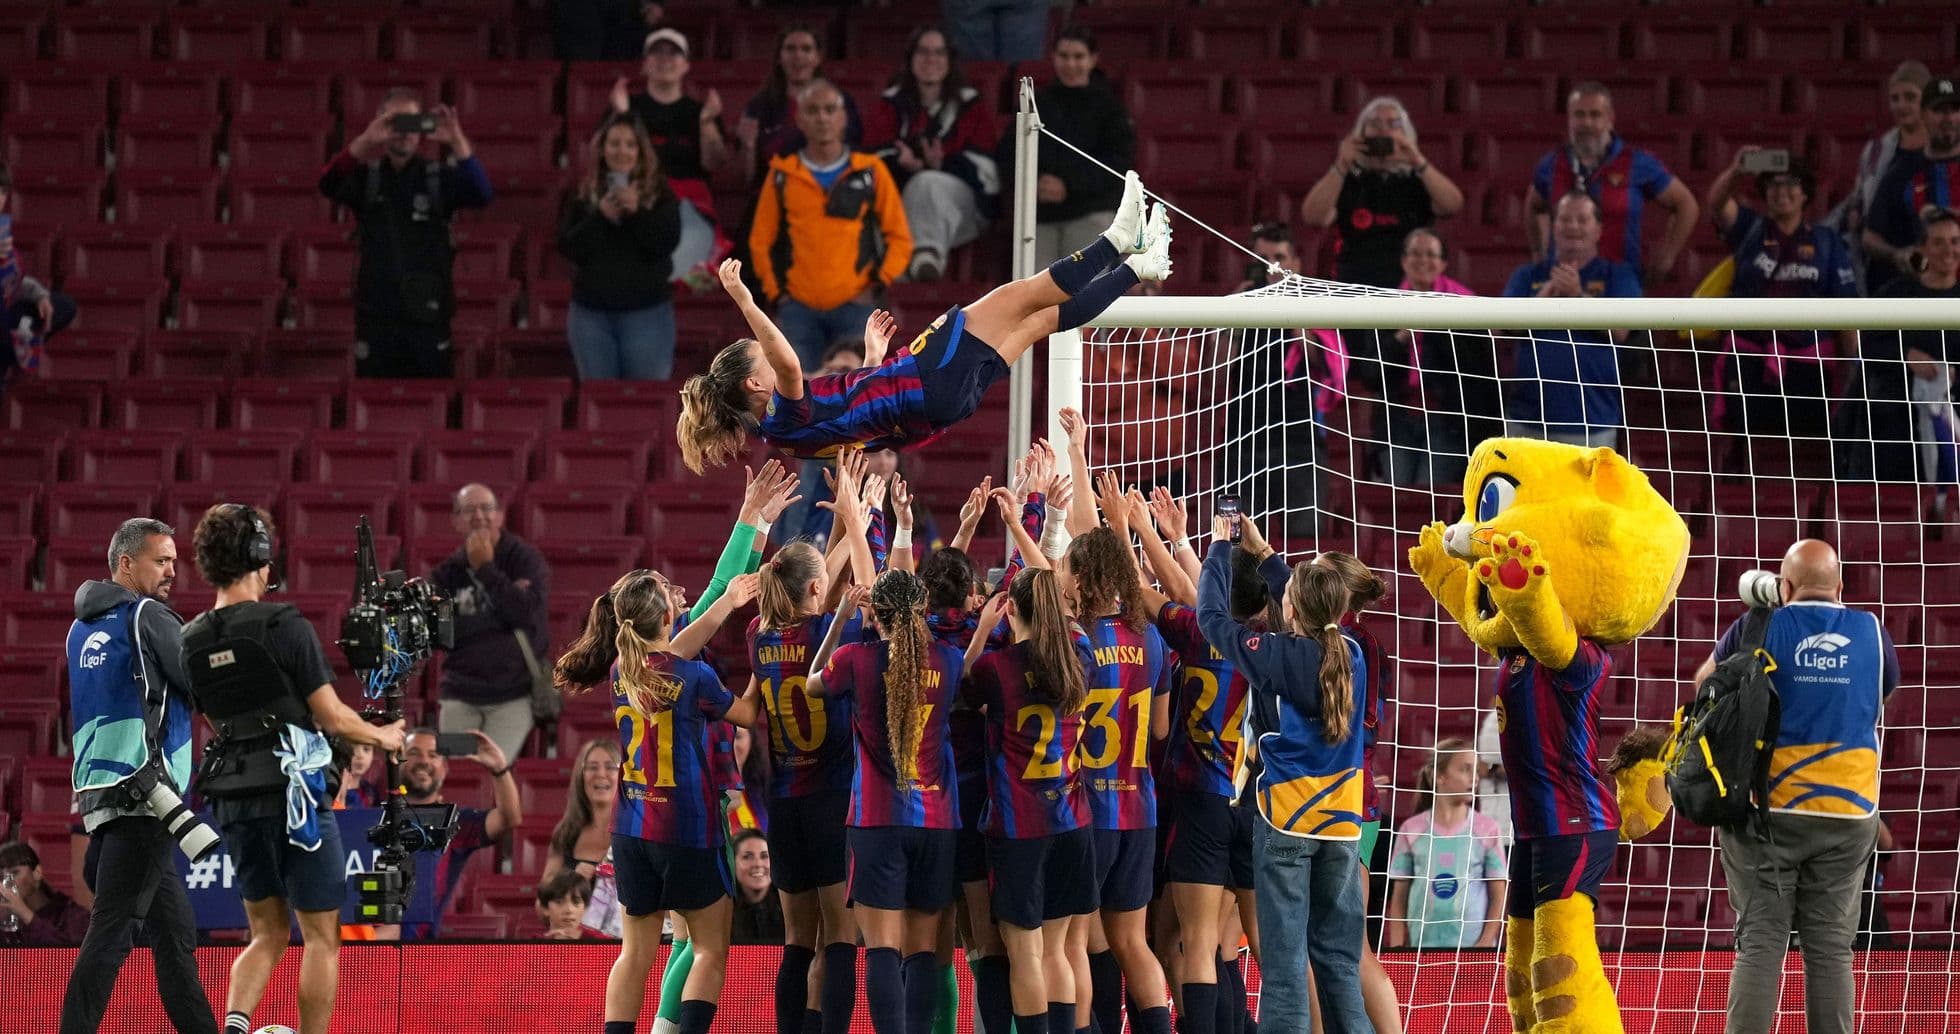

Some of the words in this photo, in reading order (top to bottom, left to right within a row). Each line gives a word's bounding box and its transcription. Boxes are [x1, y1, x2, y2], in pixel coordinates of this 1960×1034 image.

[1754, 252, 1819, 281] Rauten
[83, 653, 99, 669] Liga
[100, 652, 107, 665] F
[757, 644, 807, 665] GRAHAM
[1094, 645, 1144, 667] MAYSSA
[1804, 653, 1837, 670] Liga
[1839, 654, 1849, 669] F
[1793, 675, 1818, 683] VAMOS
[1818, 676, 1851, 685] GANANDO
[760, 675, 828, 753] 10
[1079, 686, 1152, 769] 31
[615, 705, 678, 788] 21
